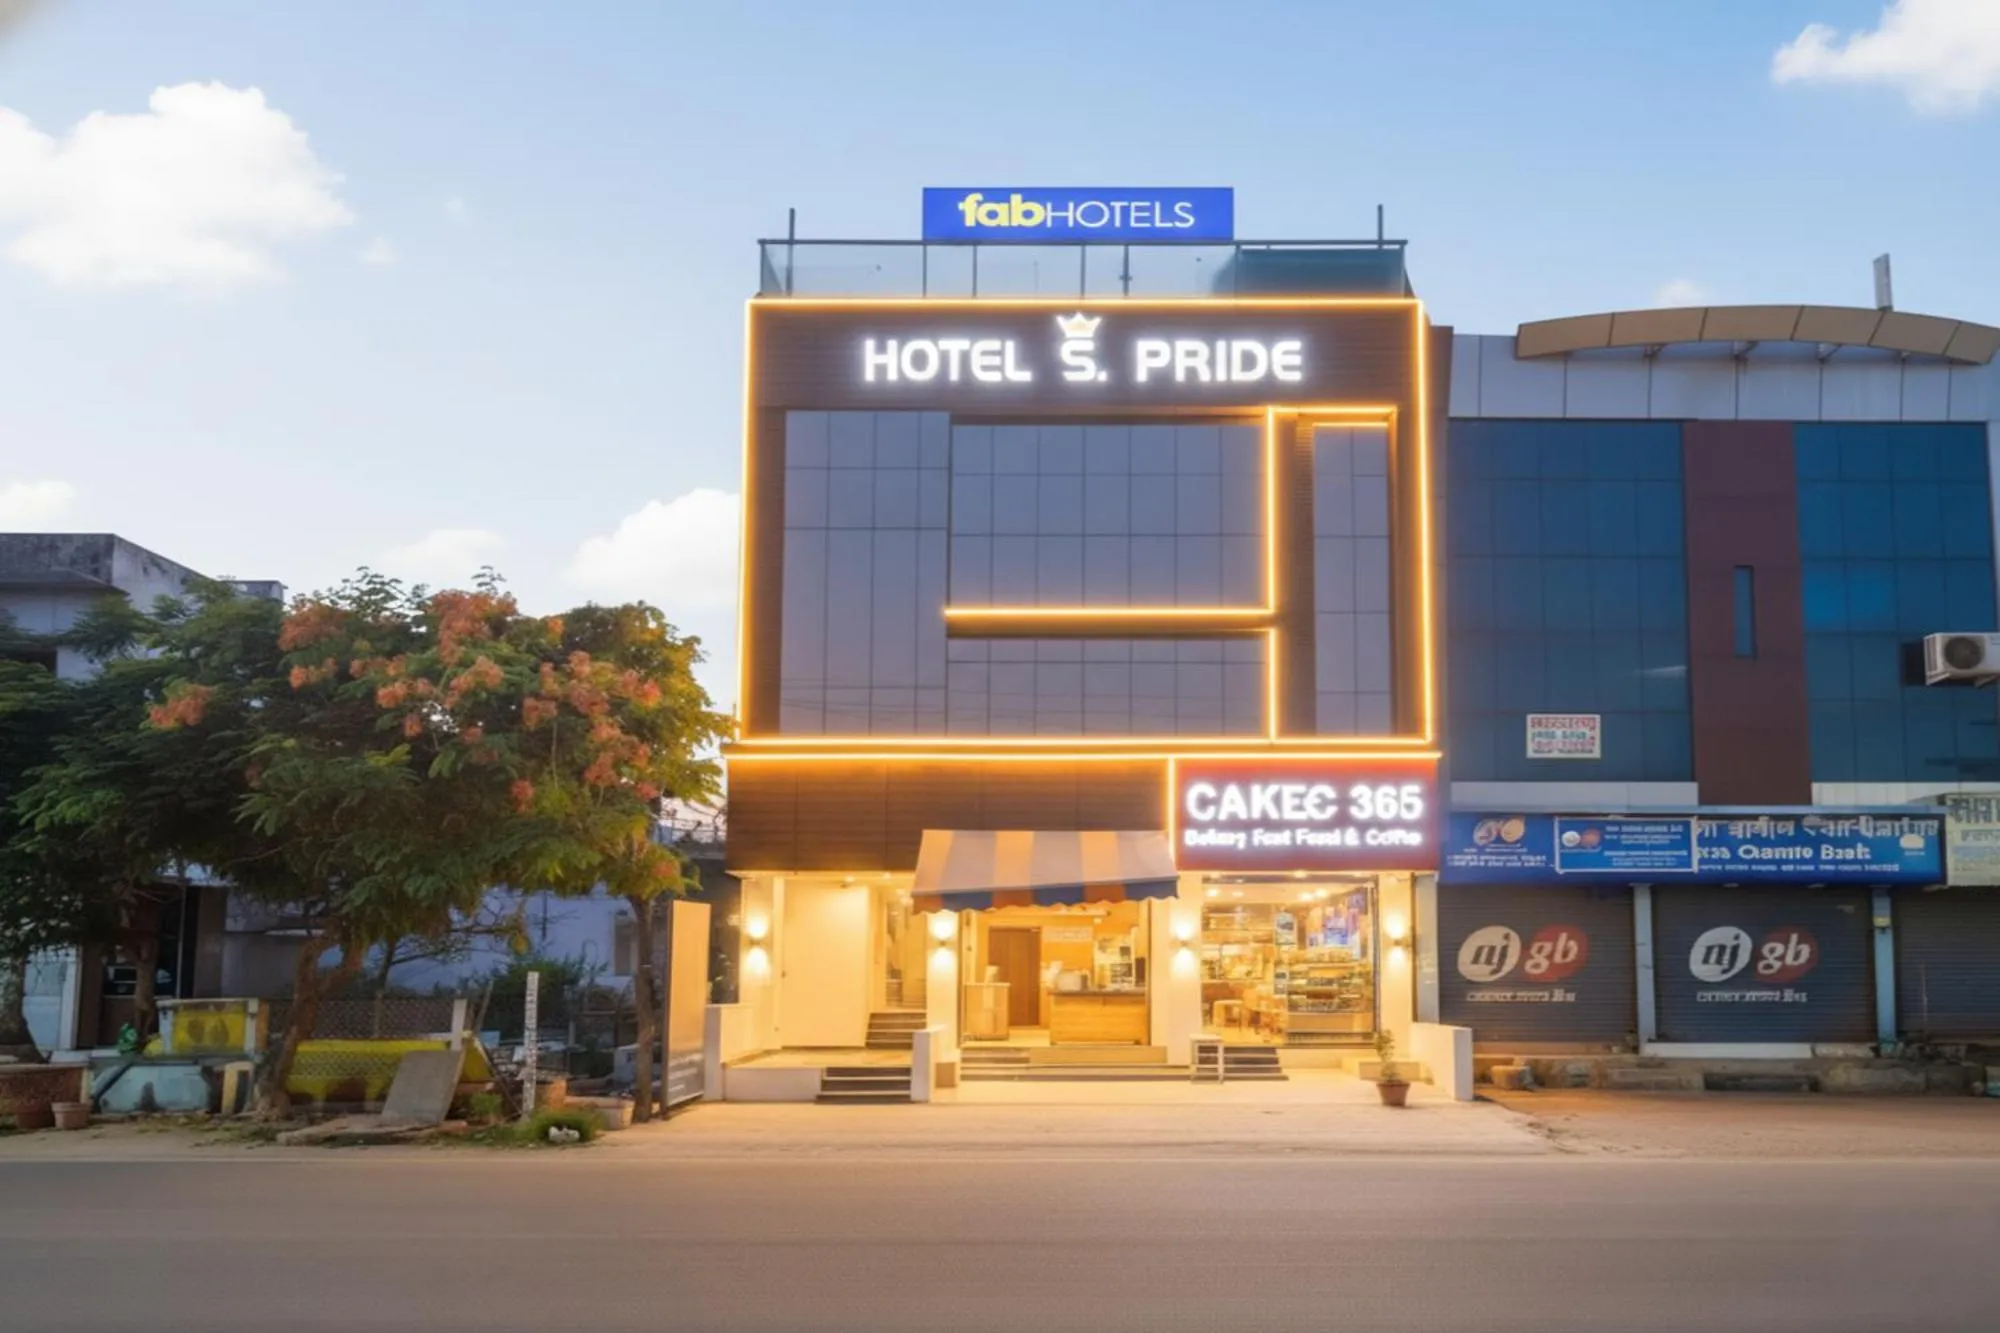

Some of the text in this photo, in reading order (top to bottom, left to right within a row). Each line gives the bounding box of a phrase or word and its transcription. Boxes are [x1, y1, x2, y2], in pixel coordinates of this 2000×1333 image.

[864, 339, 1304, 382] HOTEL S. PRIDE
[1350, 785, 1423, 820] 365
[1757, 932, 1811, 975] gb
